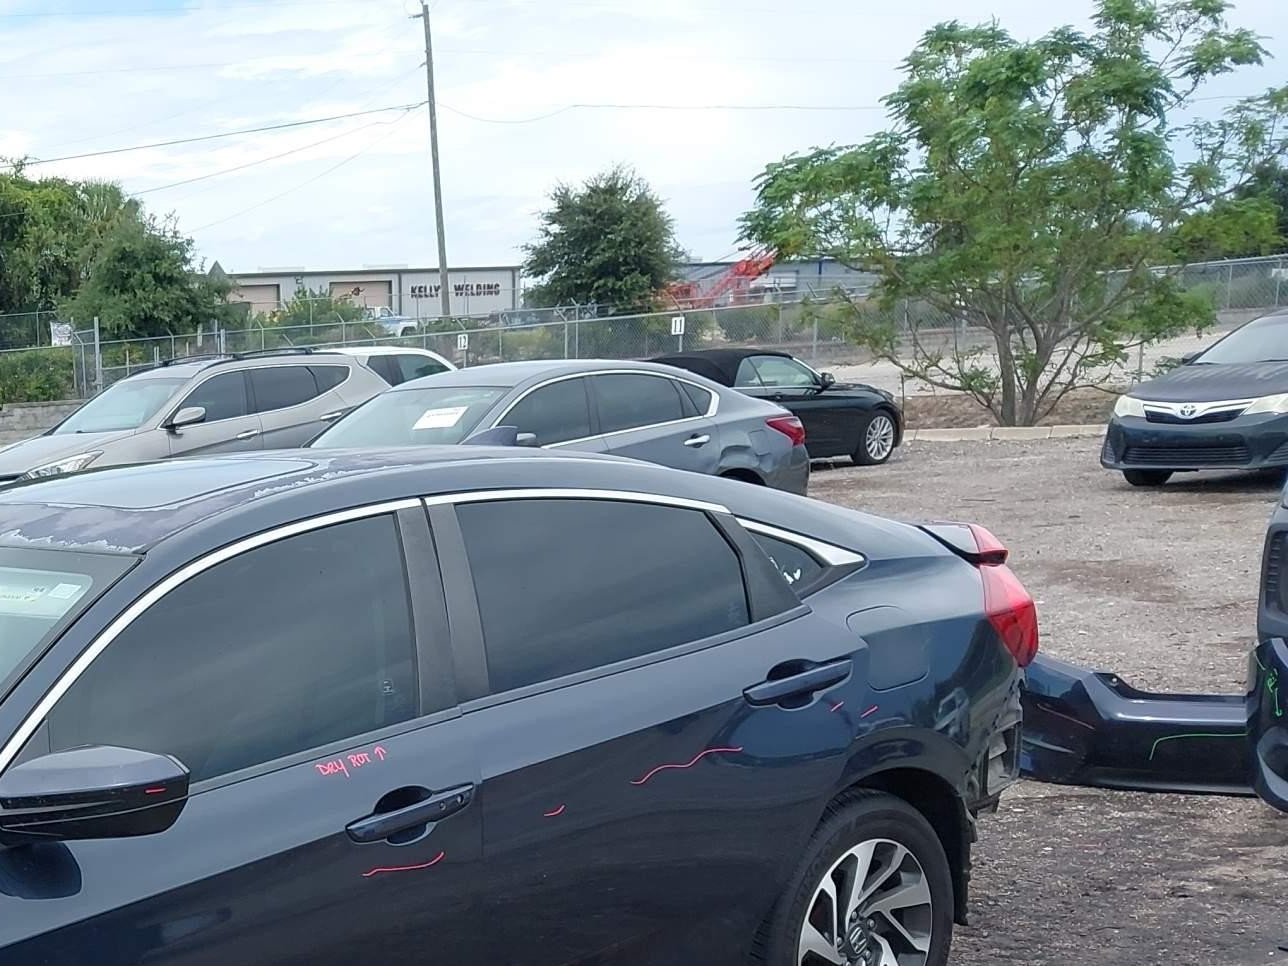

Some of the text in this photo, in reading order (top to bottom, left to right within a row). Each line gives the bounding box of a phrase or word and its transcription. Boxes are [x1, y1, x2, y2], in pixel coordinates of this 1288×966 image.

[410, 283, 501, 298] KELLY WELDING
[315, 752, 372, 778] DRY ROT
